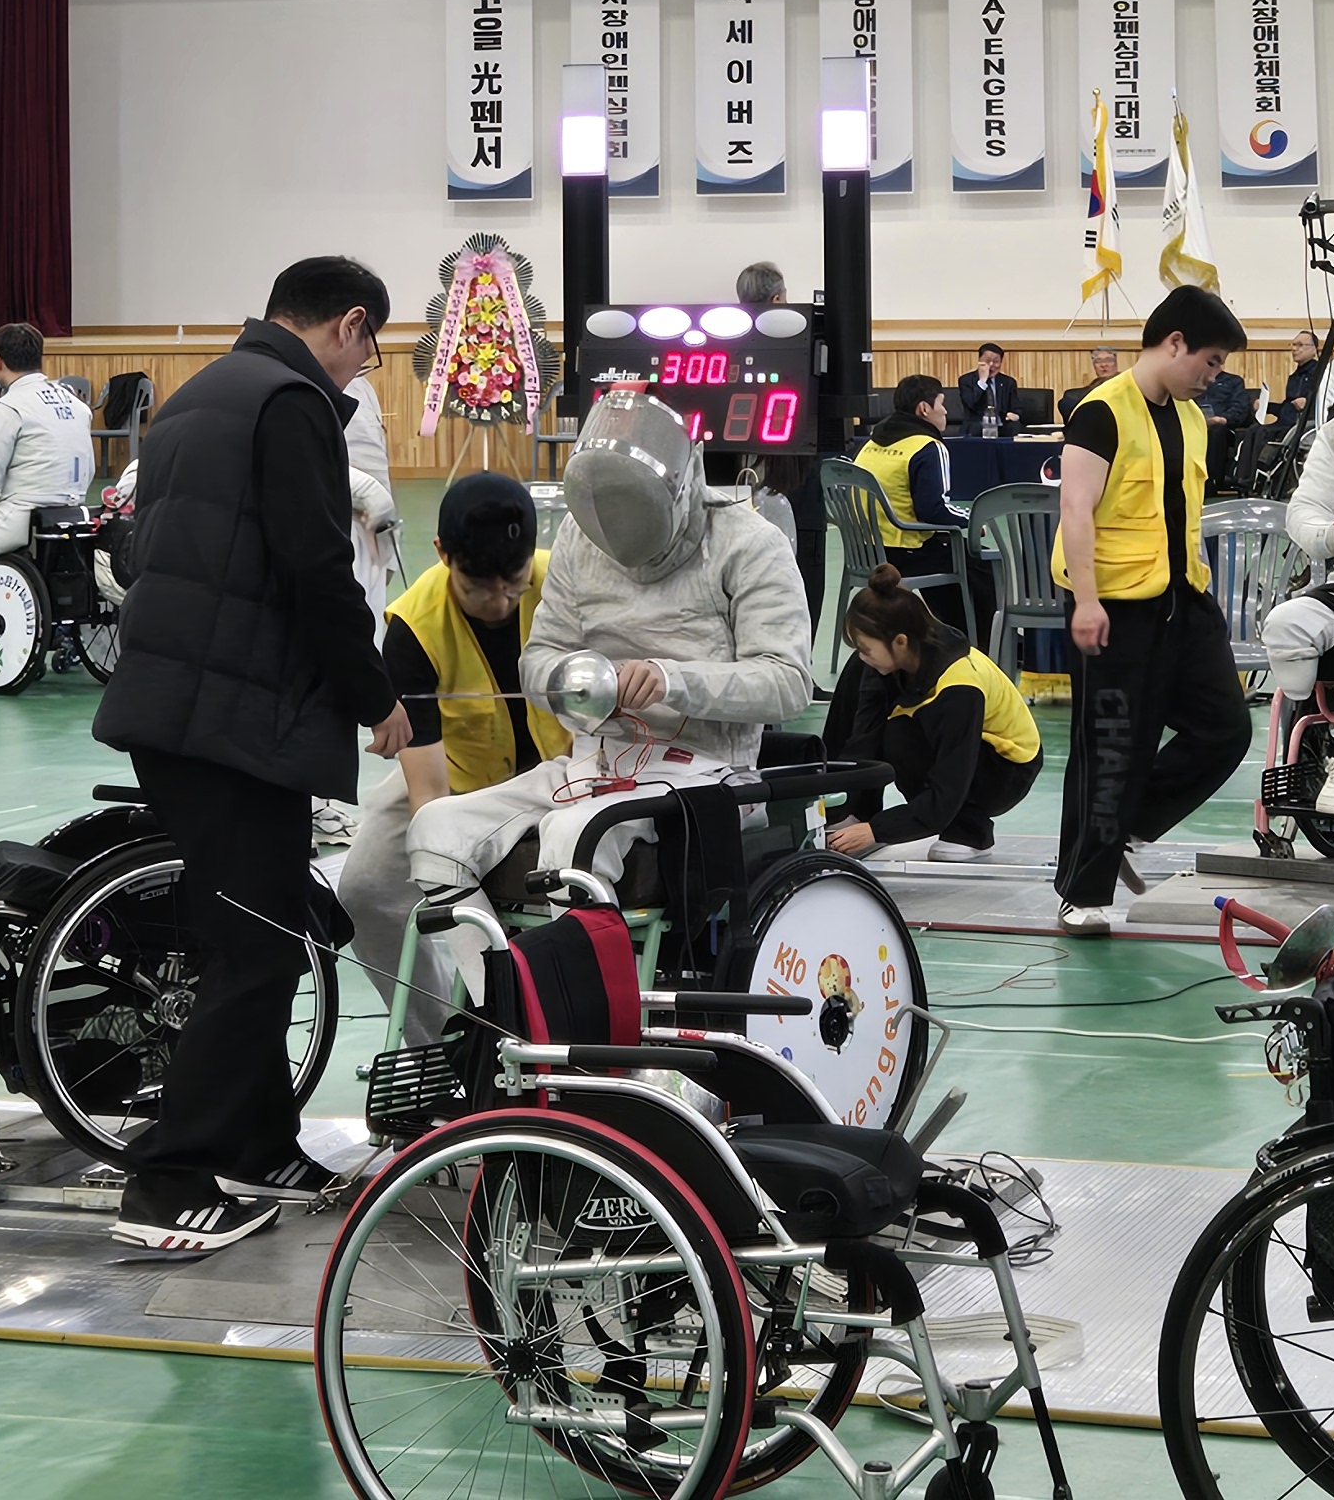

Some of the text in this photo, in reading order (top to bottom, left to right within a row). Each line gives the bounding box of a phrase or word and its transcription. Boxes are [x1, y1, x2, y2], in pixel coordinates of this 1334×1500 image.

[470, 61, 505, 170] 光펜서
[760, 390, 799, 443] 0
[1090, 688, 1133, 845] CHAMP
[840, 963, 899, 1129] vengers
